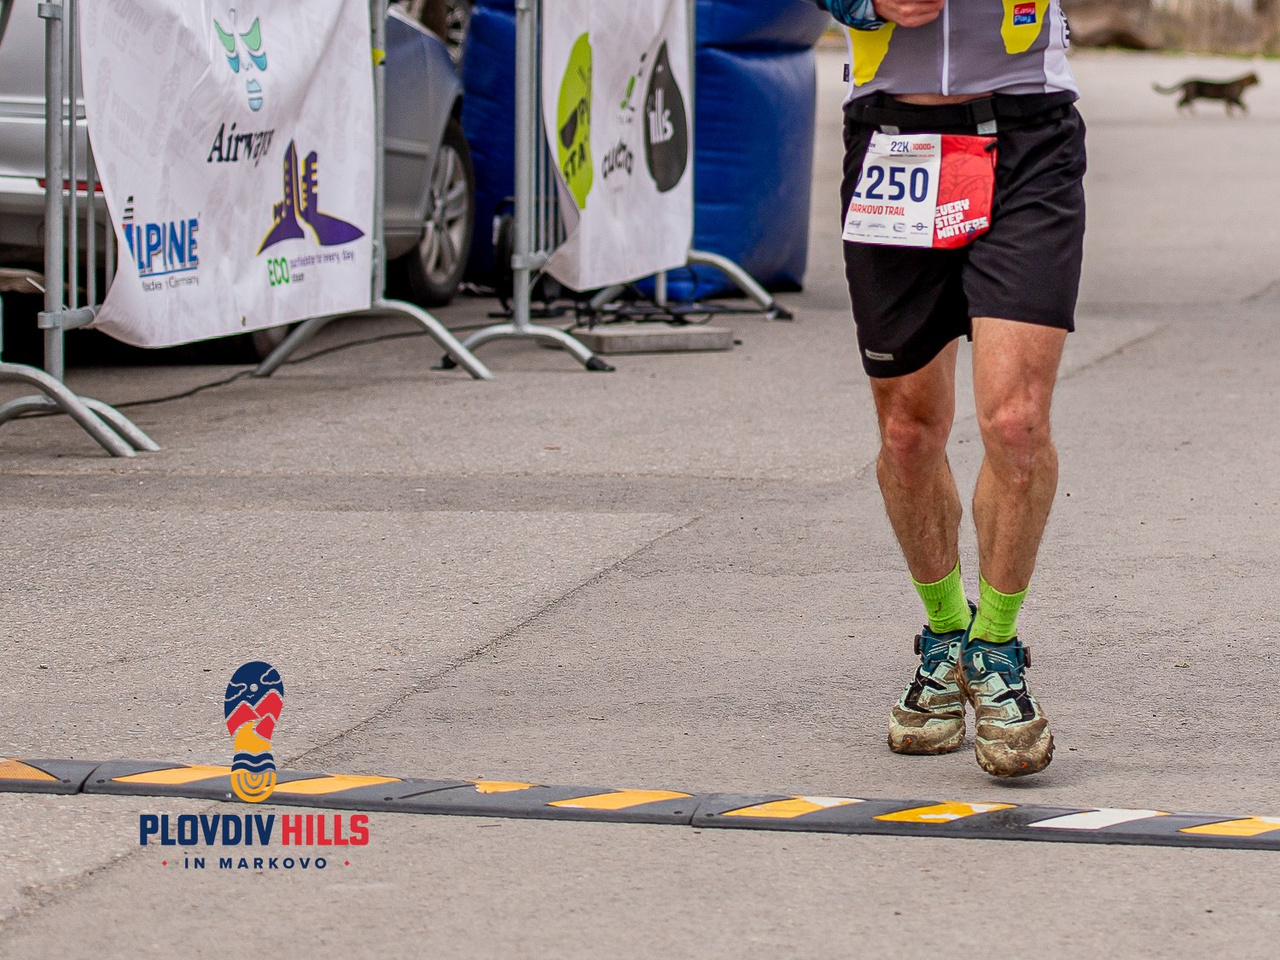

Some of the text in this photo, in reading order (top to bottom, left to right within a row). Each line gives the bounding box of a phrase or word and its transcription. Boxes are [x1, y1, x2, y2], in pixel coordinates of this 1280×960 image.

[1014, 6, 1035, 17] Easy
[890, 140, 909, 153] 22K
[885, 205, 906, 217] TRAIL
[935, 211, 964, 229] STEP
[267, 257, 290, 287] ECO
